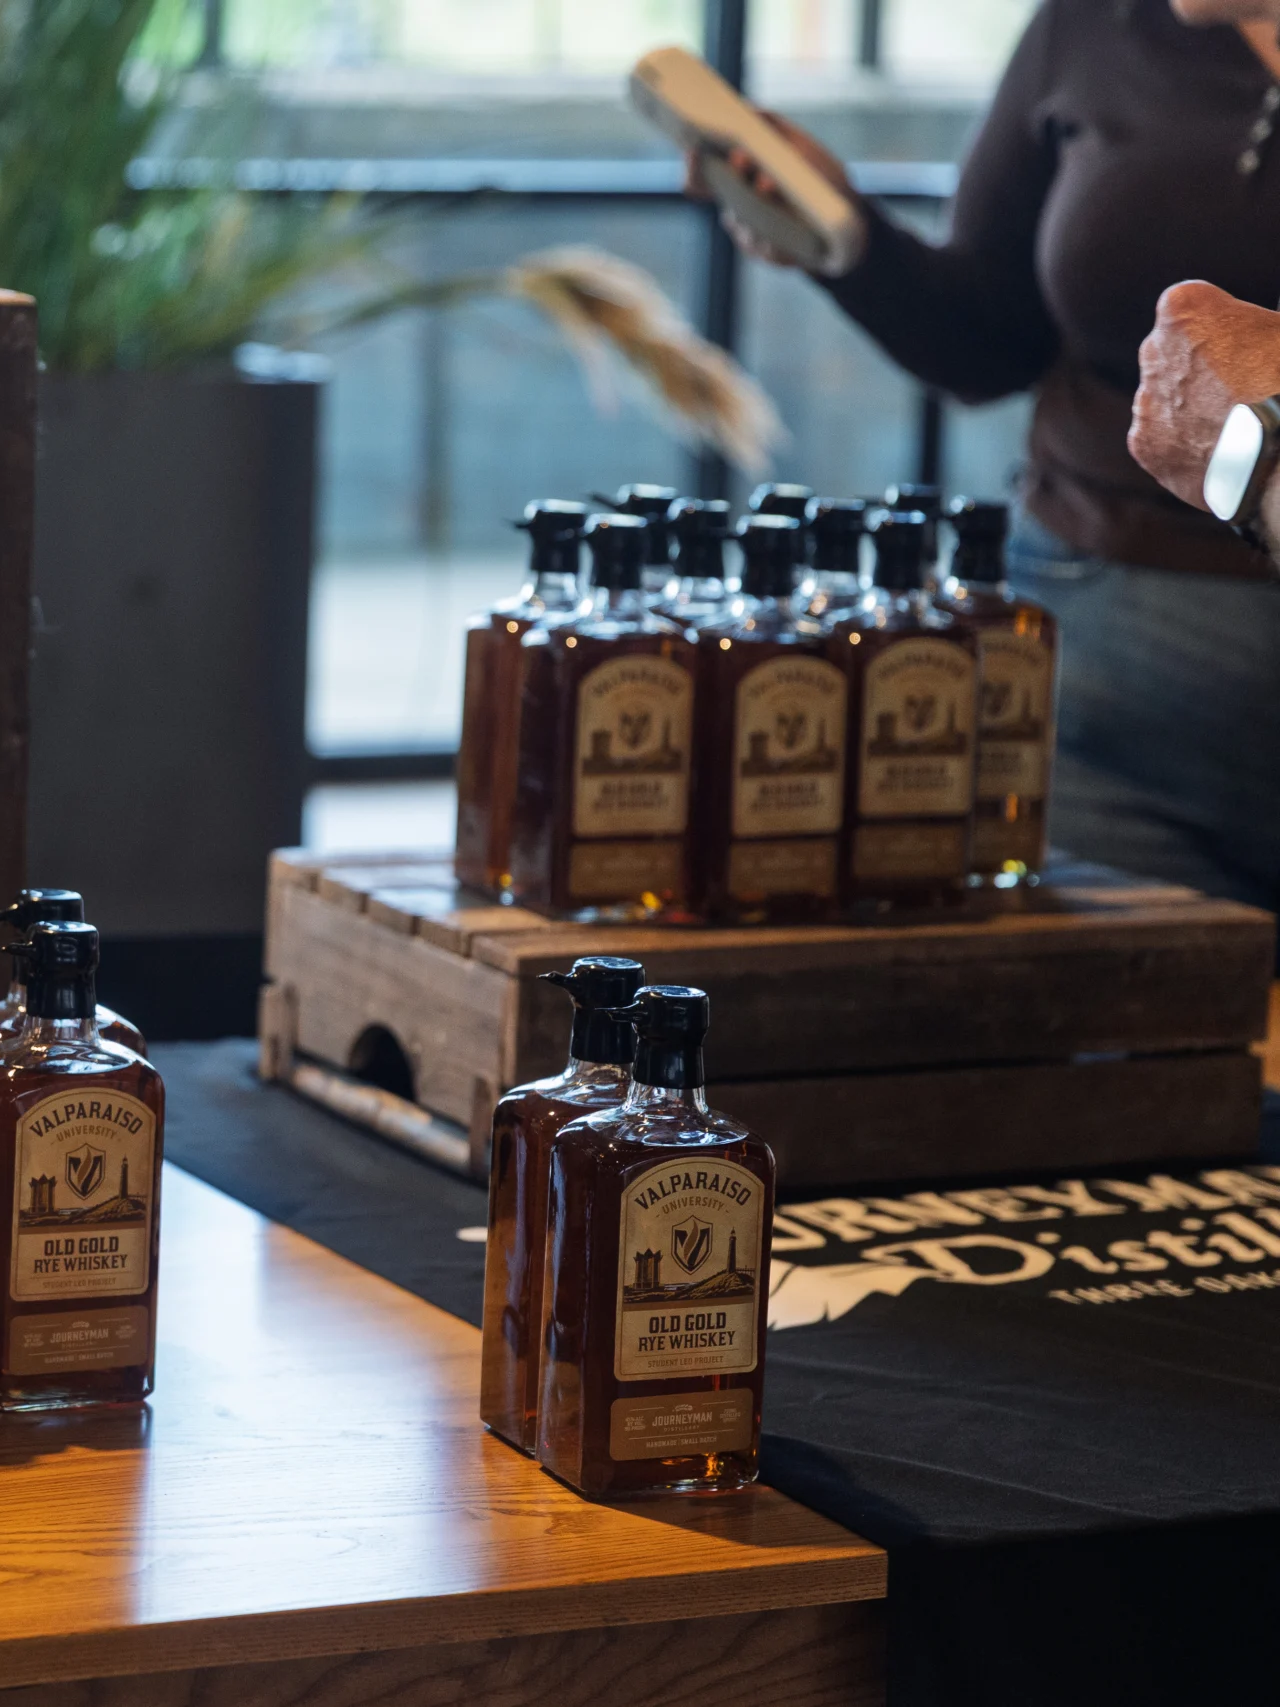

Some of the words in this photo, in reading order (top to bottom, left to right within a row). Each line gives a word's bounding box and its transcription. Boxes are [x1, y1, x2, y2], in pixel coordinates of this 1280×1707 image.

[29, 1100, 144, 1138] VALPARAISO
[56, 1124, 118, 1142] UNIVERSITY
[634, 1171, 752, 1210] VALPARAISO
[662, 1196, 725, 1214] UNIVERSITY
[44, 1238, 75, 1256] OLD
[78, 1236, 119, 1254] GOLD
[33, 1258, 60, 1274] RYE
[63, 1254, 128, 1272] WHISKEY
[649, 1315, 681, 1334] OLD
[685, 1311, 727, 1331] GOLD
[49, 1328, 110, 1344] JOURNEYMAN
[638, 1335, 666, 1352] RYE
[669, 1330, 736, 1350] WHISKEY
[648, 1359, 679, 1368] STUDENT
[680, 1357, 693, 1365] LED
[694, 1355, 724, 1364] PROJECT
[652, 1411, 713, 1427] JOURNEYMAN
[646, 1438, 677, 1448] HANDMADE
[680, 1437, 698, 1446] SMALL
[699, 1436, 717, 1444] BATCH
